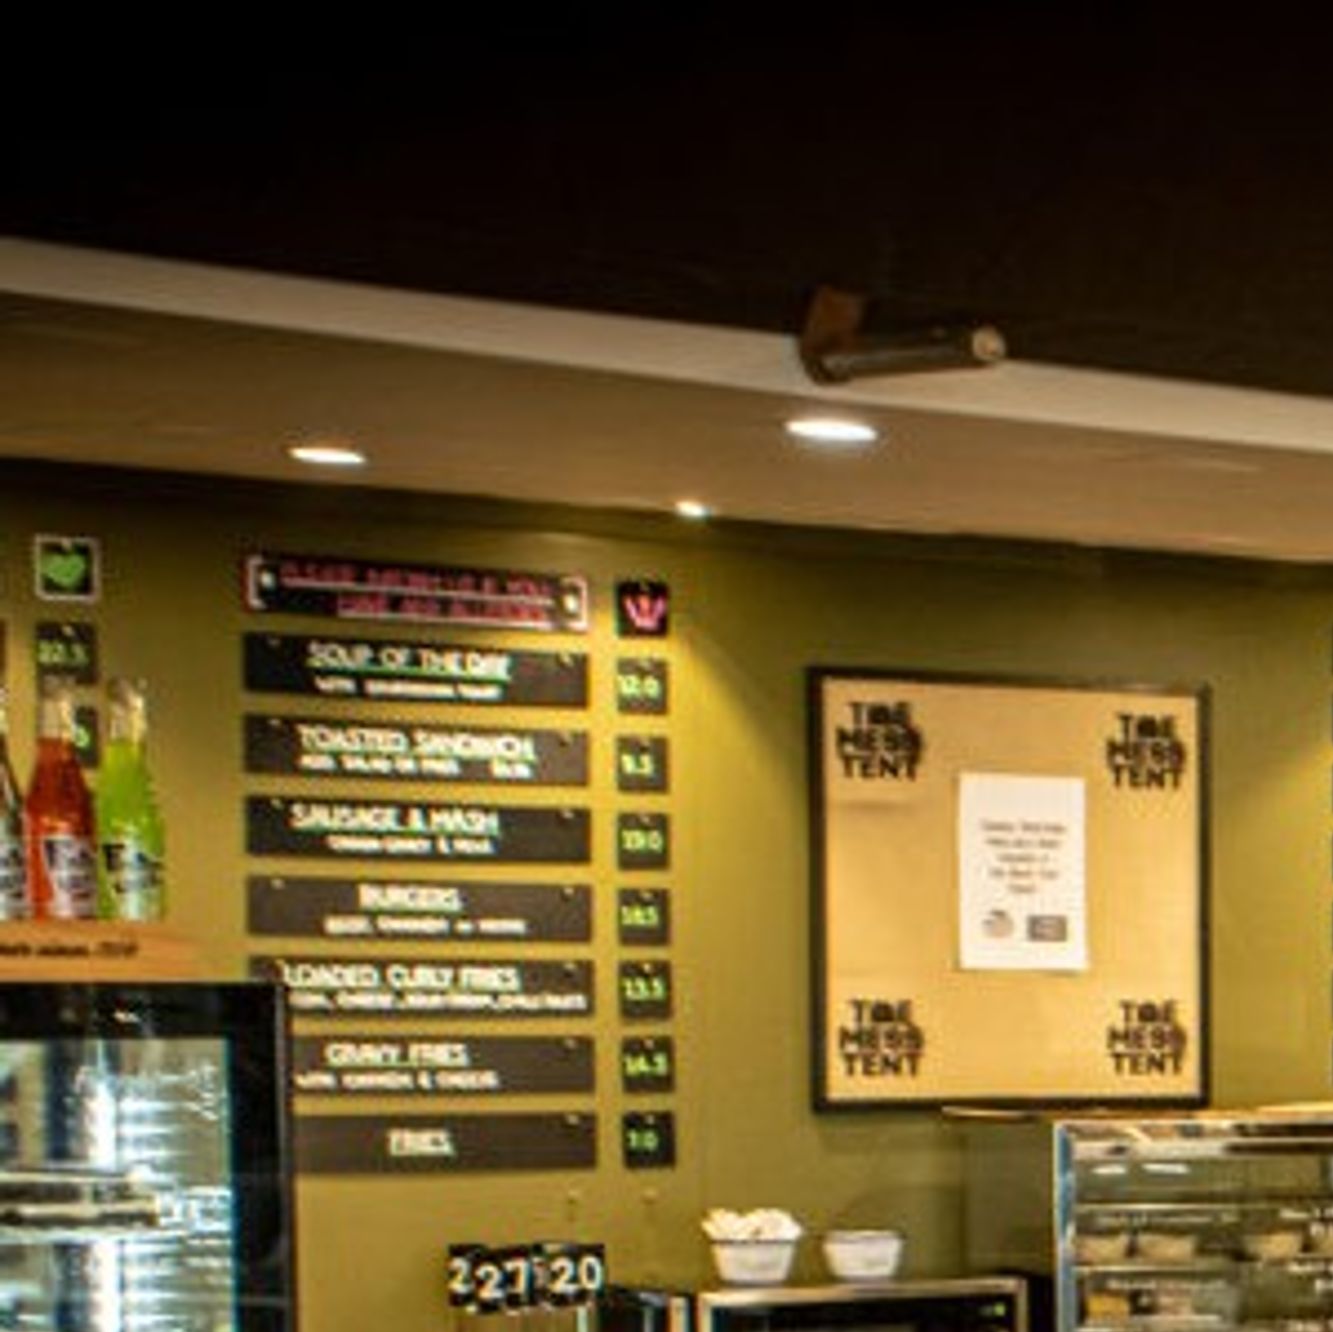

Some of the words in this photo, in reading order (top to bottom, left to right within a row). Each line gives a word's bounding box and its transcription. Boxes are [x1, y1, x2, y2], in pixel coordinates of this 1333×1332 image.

[306, 641, 372, 668] SOUP
[379, 646, 410, 669] OF
[296, 724, 409, 752] TOASTED
[842, 752, 918, 782] TENT
[1112, 762, 1183, 790] TENT
[289, 803, 398, 831] SAUSAGE
[430, 808, 498, 835] MASH
[358, 883, 463, 912] BURGERS
[282, 963, 380, 987] LOADED
[386, 963, 453, 989] CURLY
[459, 966, 523, 992] FRIES
[326, 1043, 400, 1067] GRAVY
[408, 1043, 471, 1067] FRIES
[844, 1050, 921, 1077] TENT
[1111, 1051, 1184, 1076] TENT
[388, 1128, 455, 1157] FRIES
[551, 1255, 603, 1295] 20
